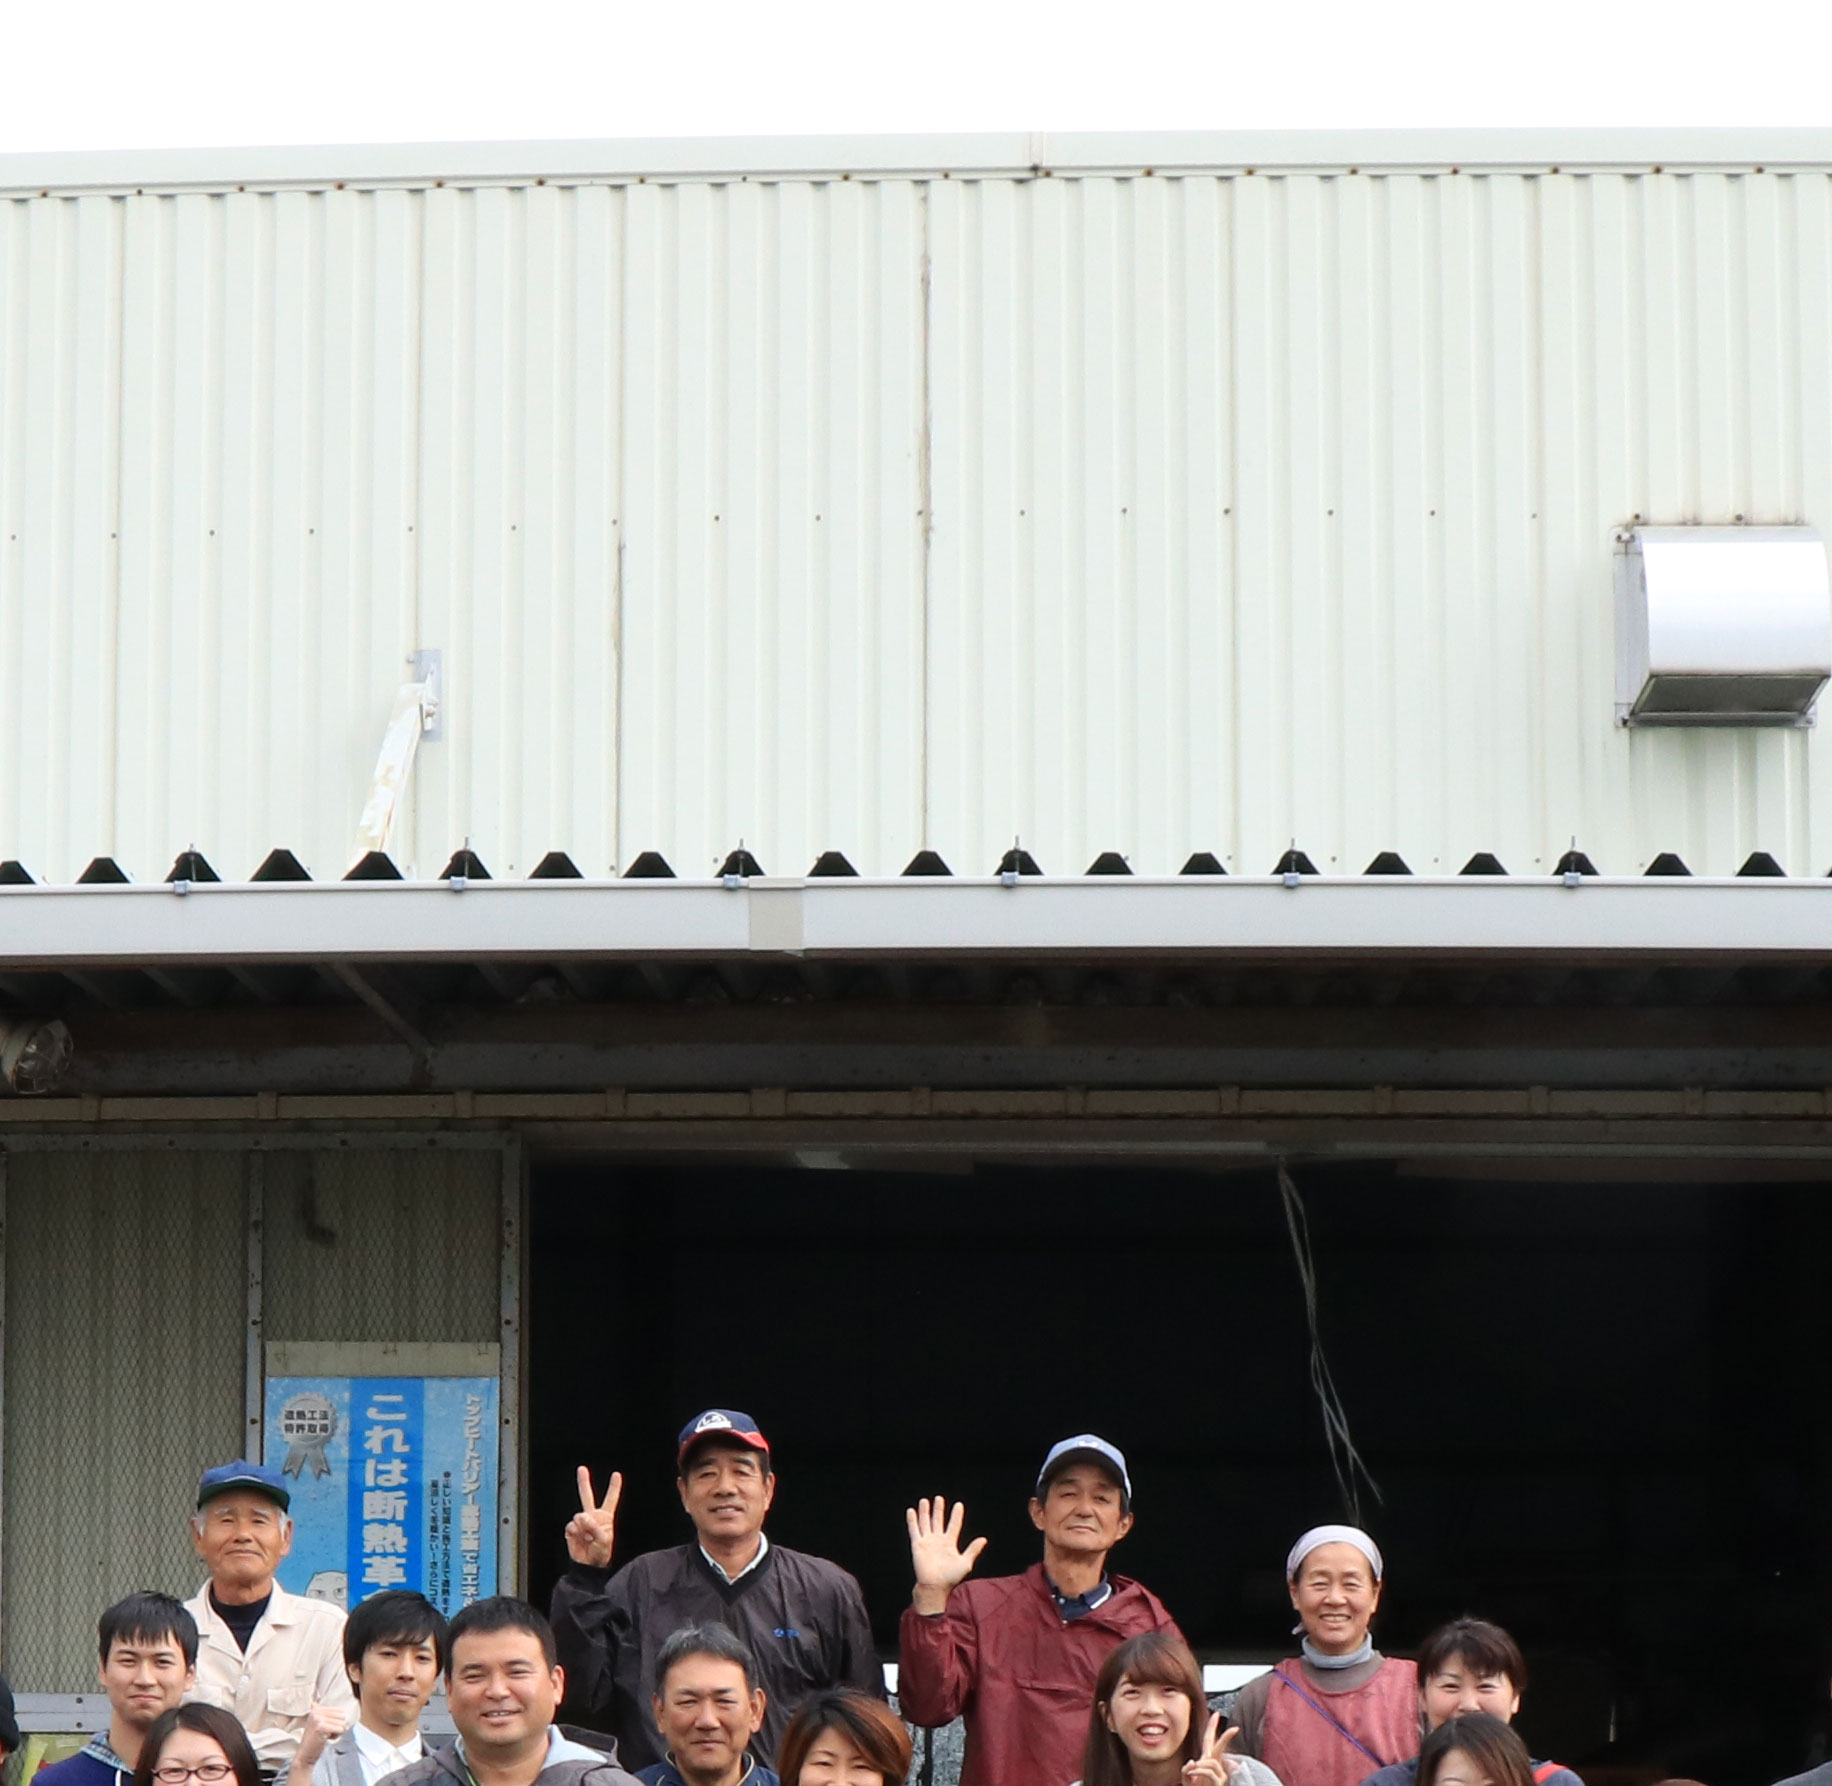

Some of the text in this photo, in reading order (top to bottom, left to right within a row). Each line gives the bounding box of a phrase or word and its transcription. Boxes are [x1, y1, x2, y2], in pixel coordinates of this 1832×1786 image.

[362, 1394, 410, 1600] これは断熱革
